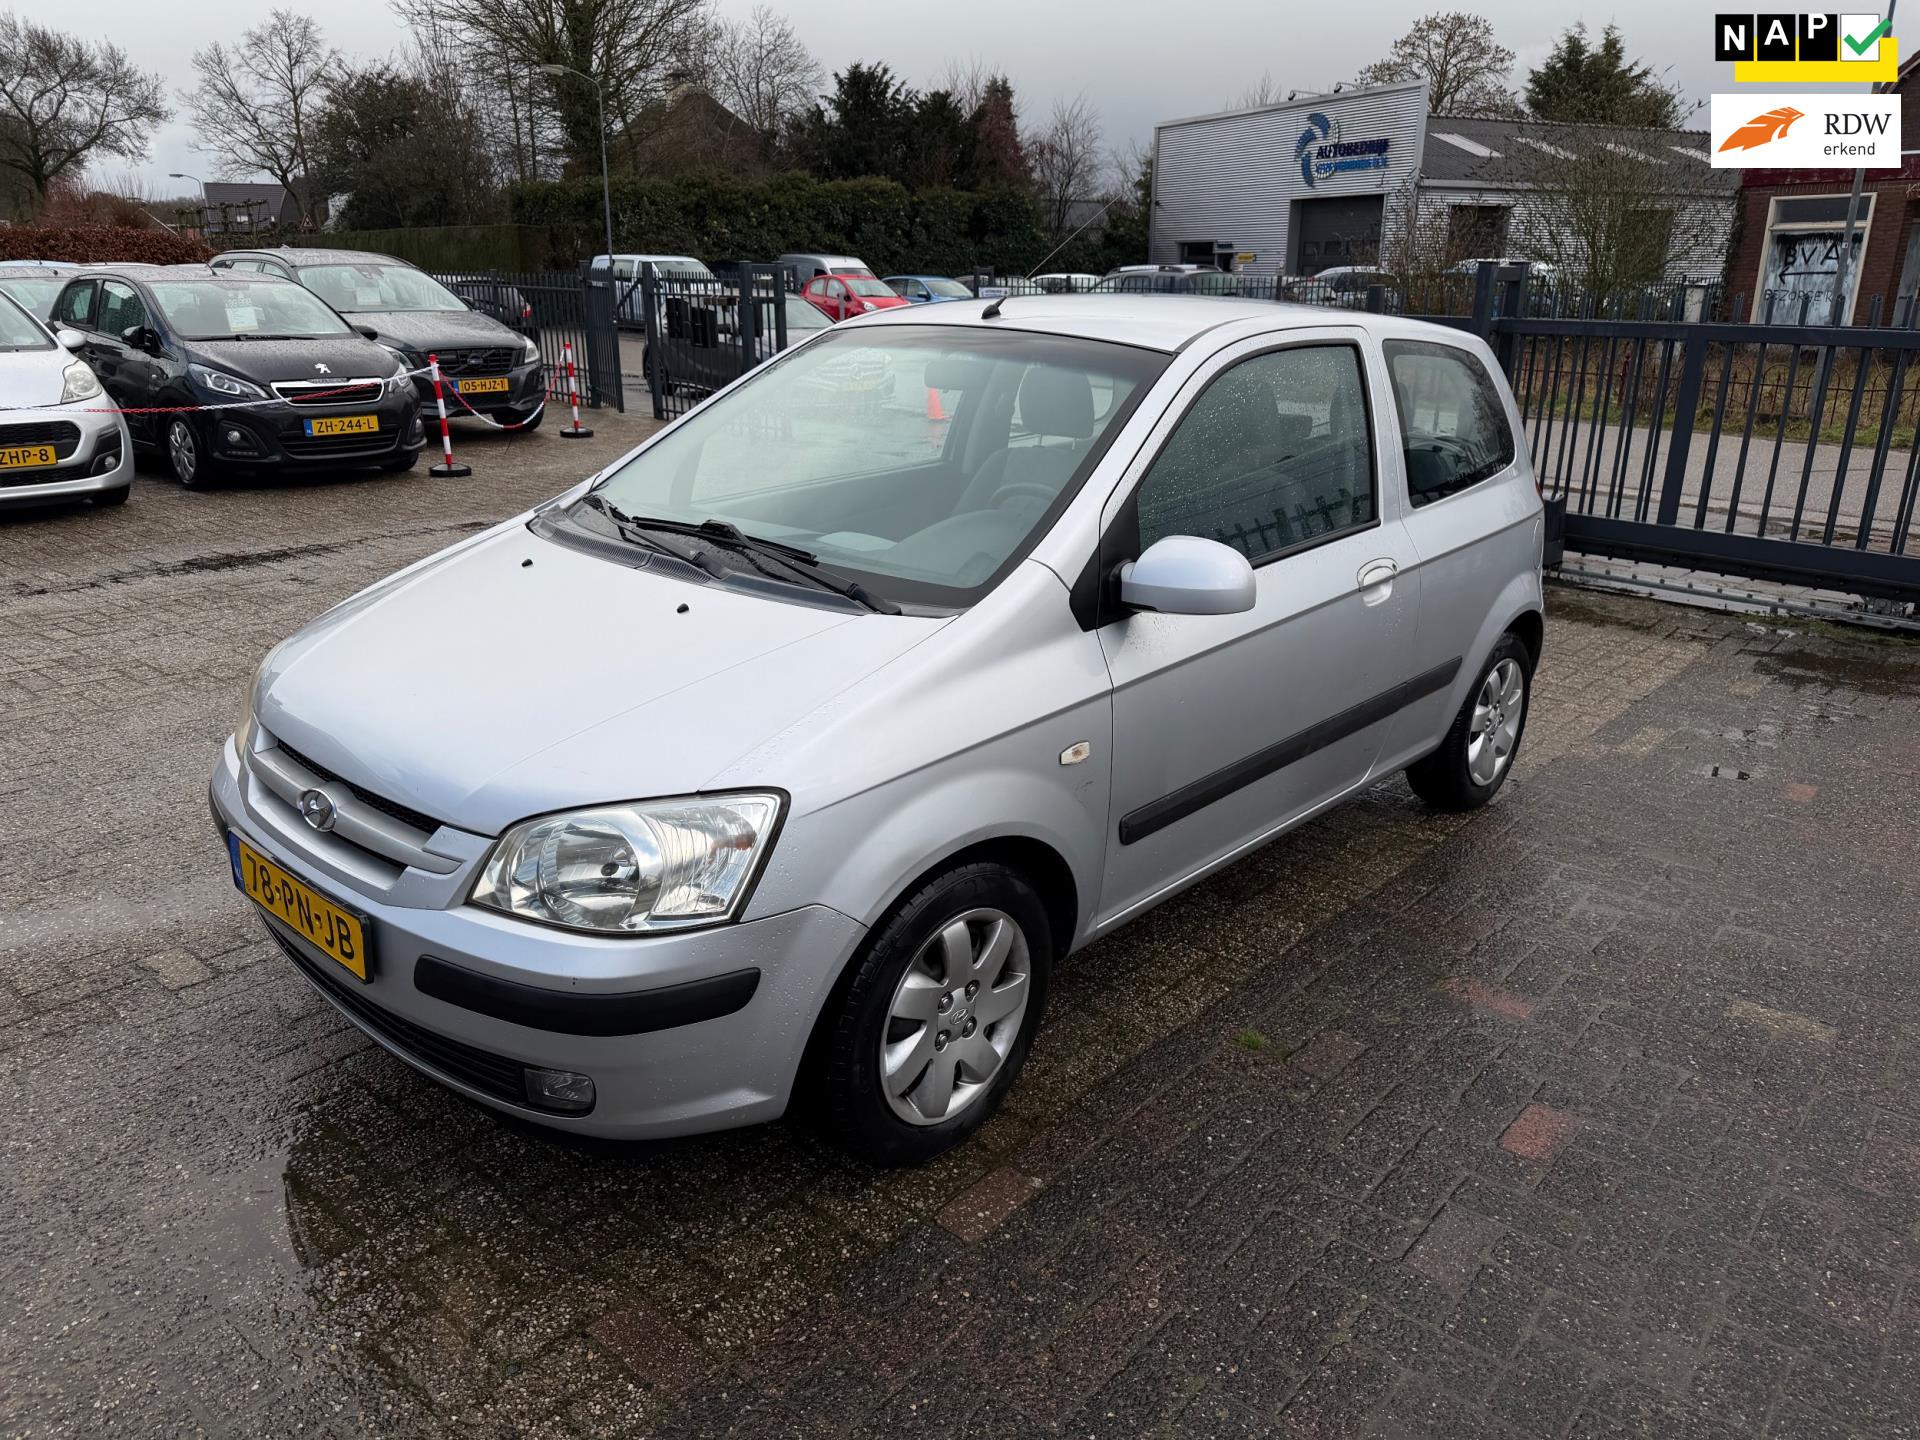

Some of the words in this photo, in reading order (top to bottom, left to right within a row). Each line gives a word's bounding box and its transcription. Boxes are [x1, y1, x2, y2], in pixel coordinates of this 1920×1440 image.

[316, 418, 375, 434] ZH-244-L
[0, 448, 50, 464] ZHP-8
[246, 852, 355, 960] 78-PN-JB
